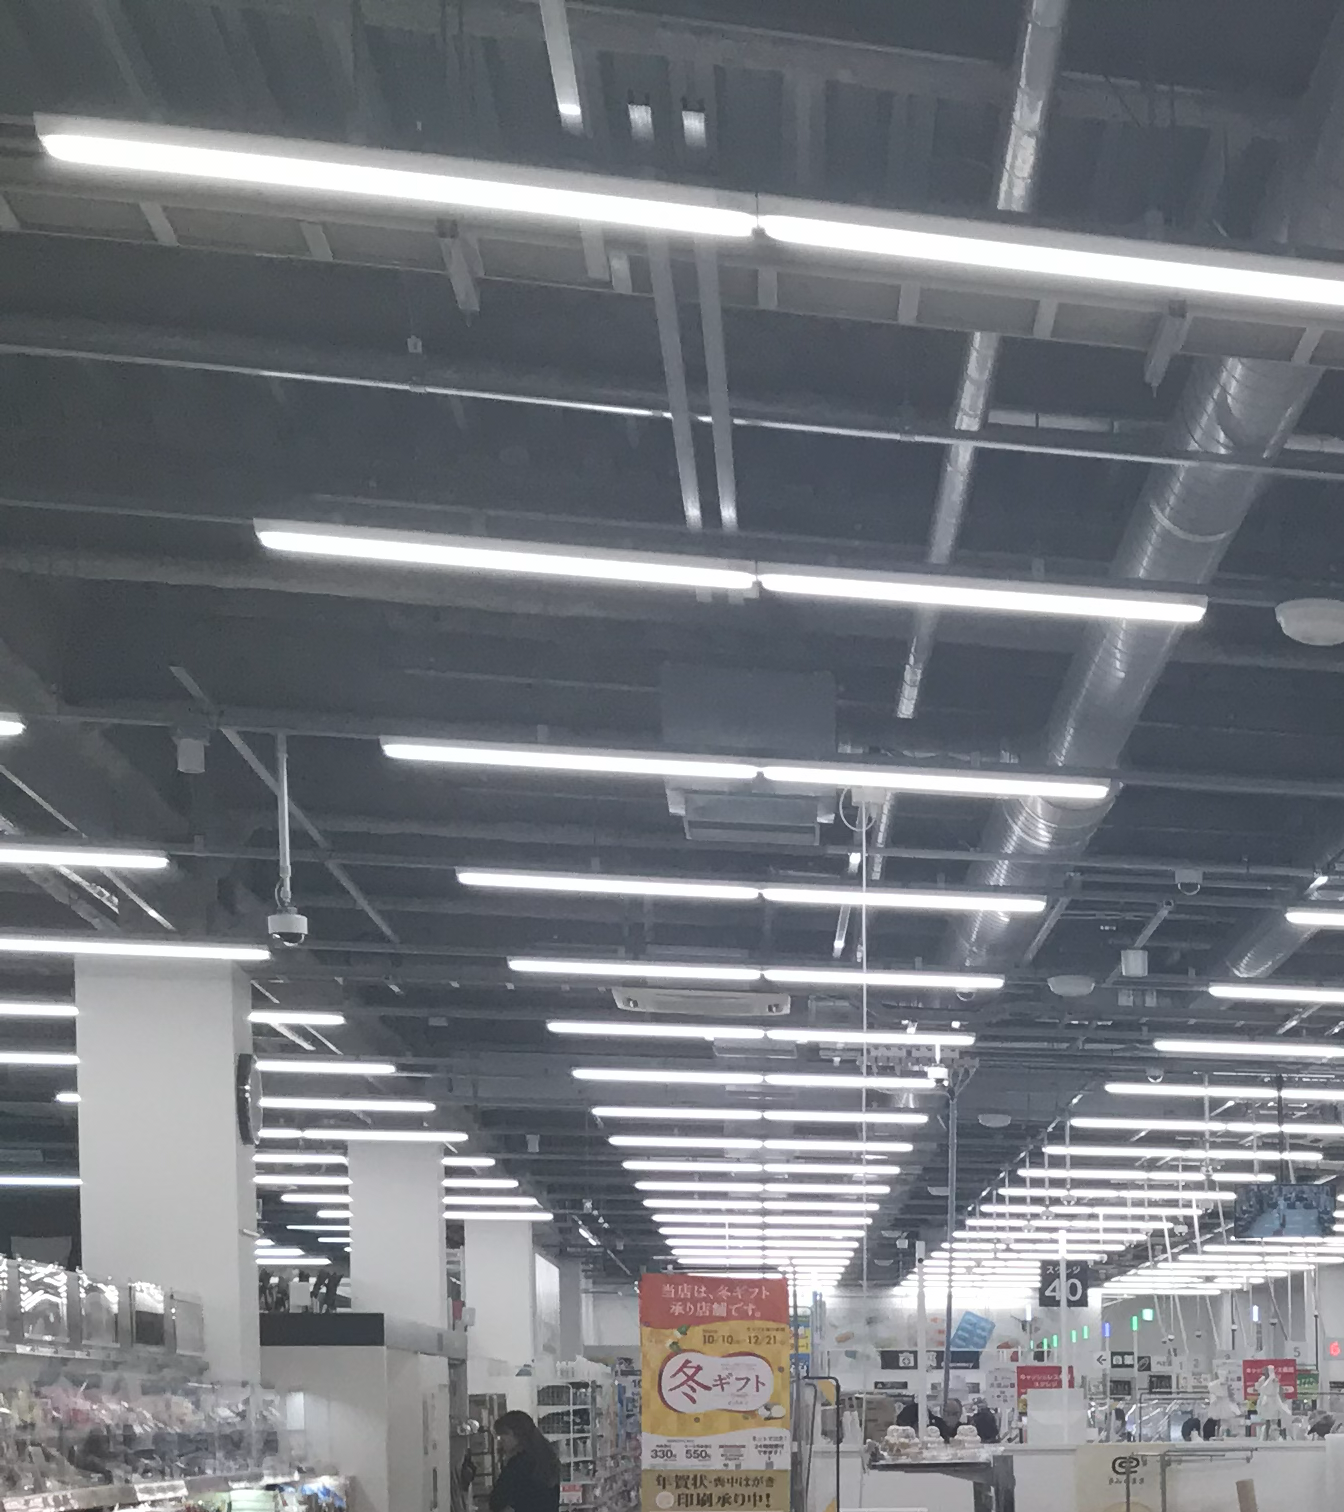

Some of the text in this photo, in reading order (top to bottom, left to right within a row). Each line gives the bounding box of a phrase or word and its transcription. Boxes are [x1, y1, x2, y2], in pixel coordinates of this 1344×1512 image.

[662, 1284, 770, 1299] 当店は、冬ギフト
[1044, 1278, 1083, 1301] 40
[670, 1302, 761, 1318] 承り店舗です。
[668, 1358, 767, 1405] 冬ギフト
